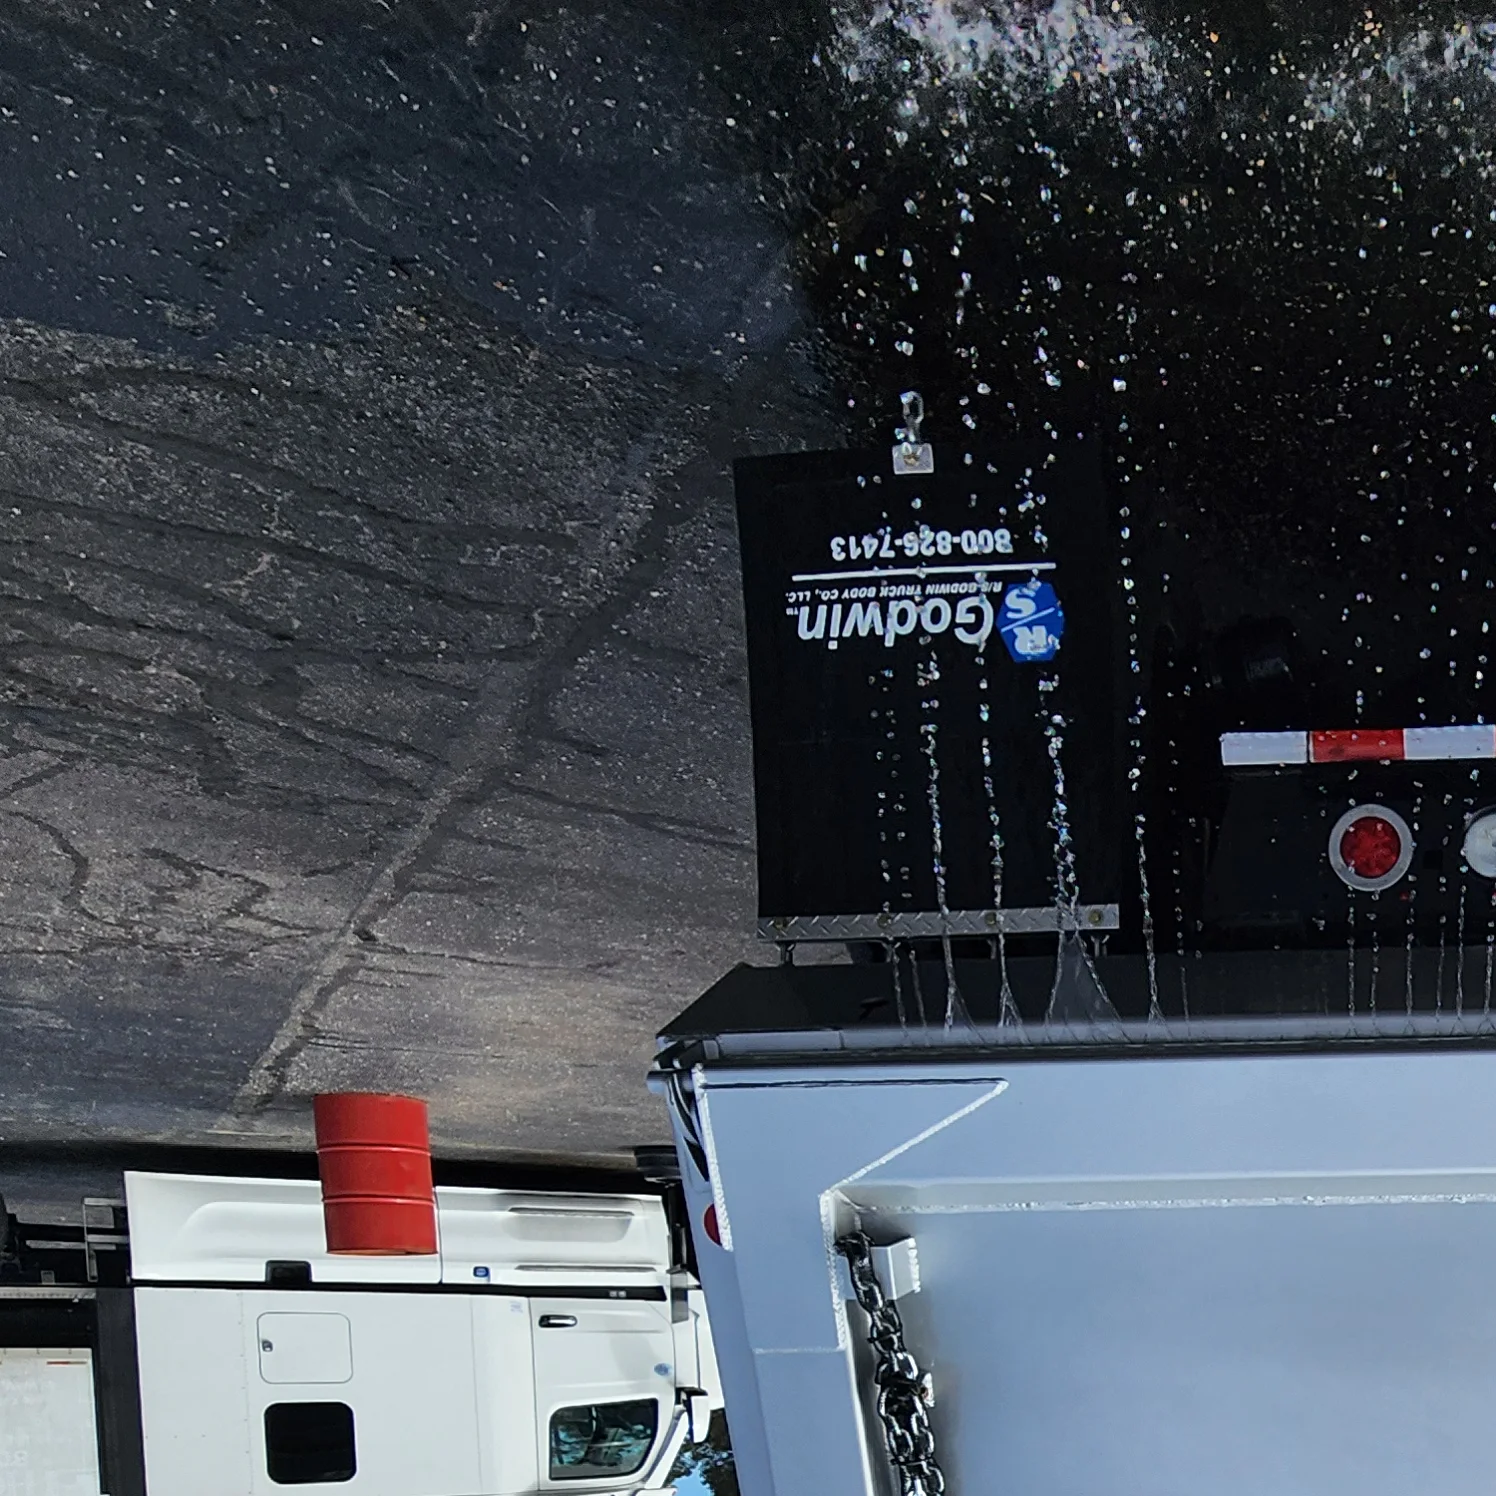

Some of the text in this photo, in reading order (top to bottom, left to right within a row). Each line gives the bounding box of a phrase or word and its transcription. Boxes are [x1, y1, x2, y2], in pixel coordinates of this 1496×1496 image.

[830, 528, 1014, 561] 800-826-7413
[844, 586, 877, 599] BODY
[797, 596, 994, 650] Godwin
